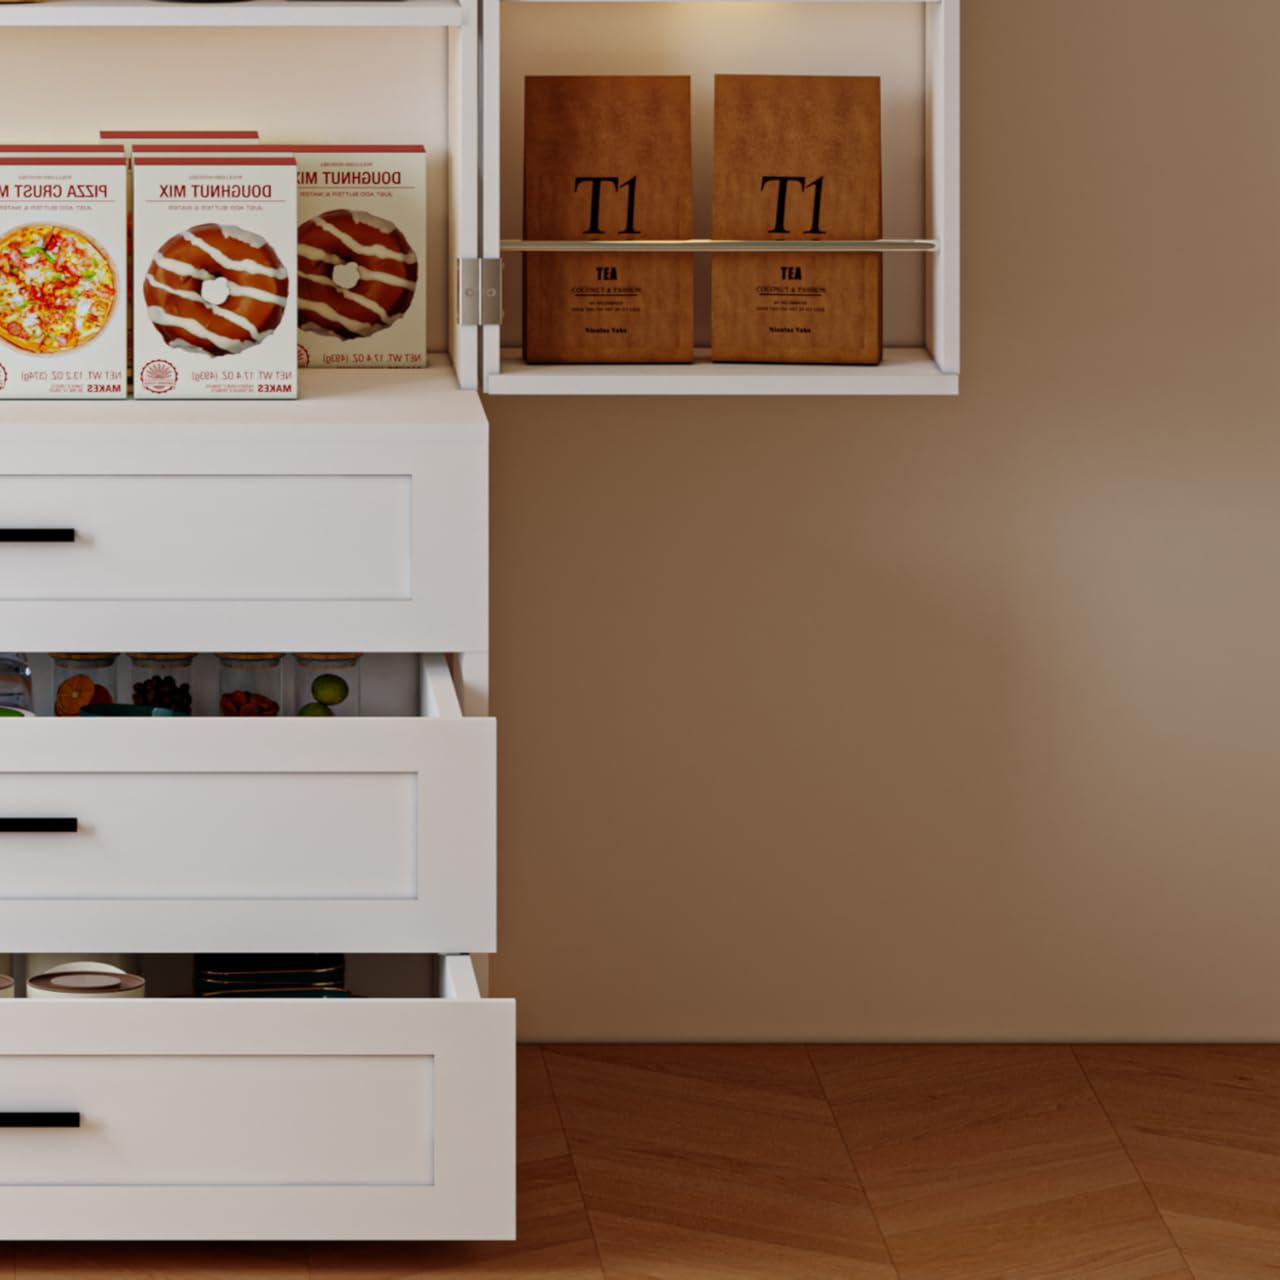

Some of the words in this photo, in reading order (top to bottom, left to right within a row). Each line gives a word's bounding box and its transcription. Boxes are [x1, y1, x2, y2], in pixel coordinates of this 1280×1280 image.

[574, 176, 642, 234] T1
[760, 176, 827, 234] T1
[595, 267, 618, 281] TEA
[780, 266, 802, 280] TEA
